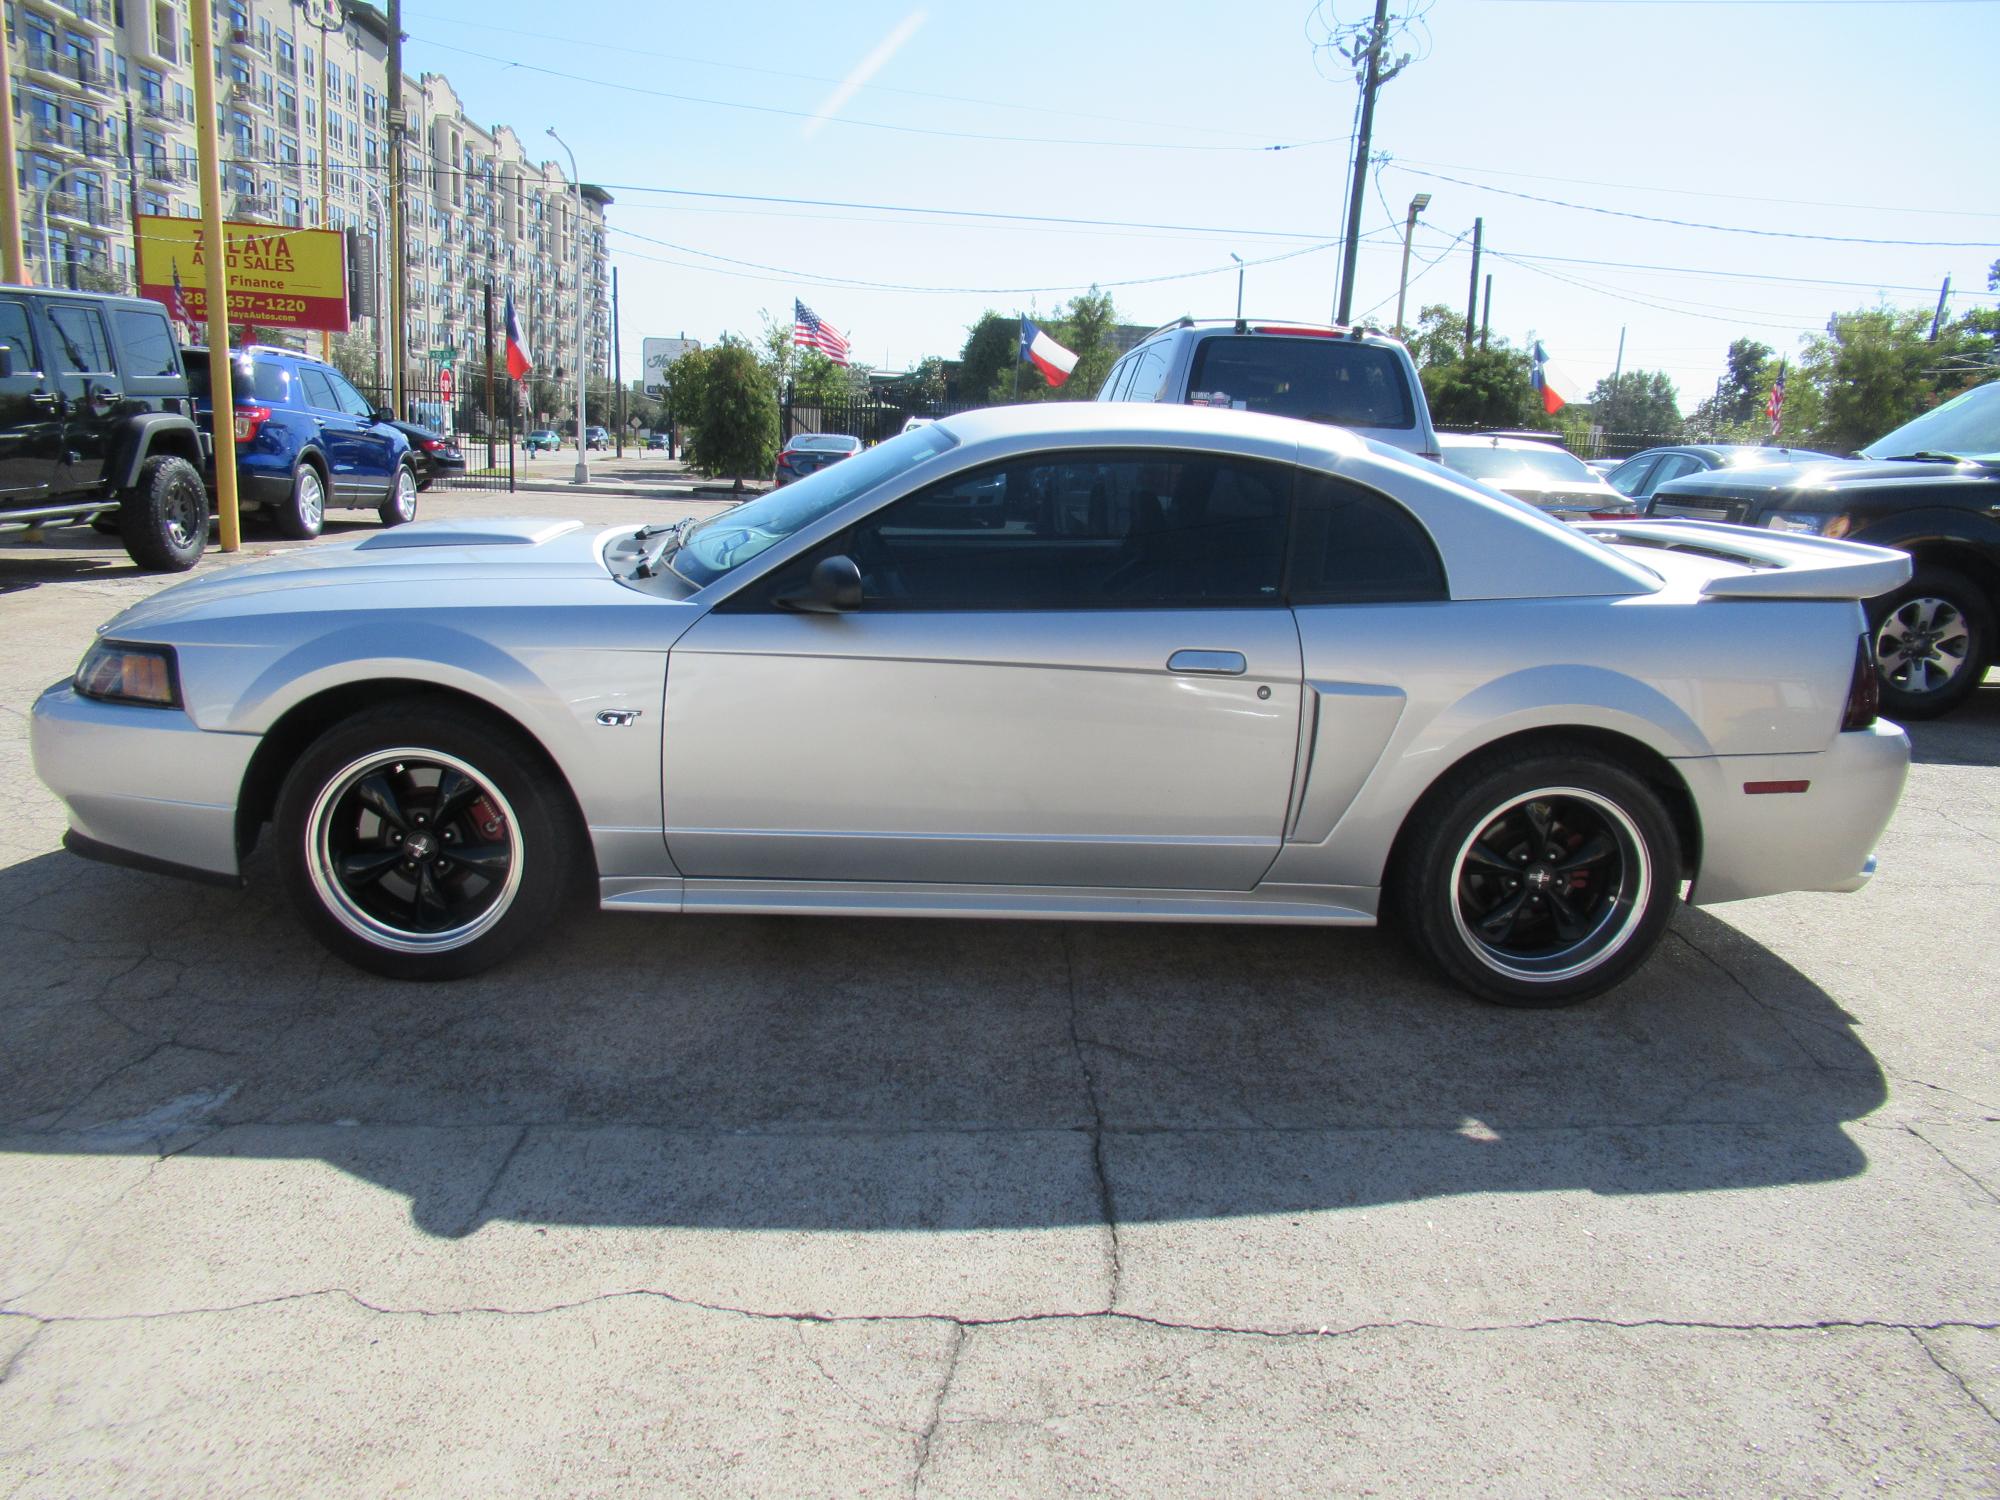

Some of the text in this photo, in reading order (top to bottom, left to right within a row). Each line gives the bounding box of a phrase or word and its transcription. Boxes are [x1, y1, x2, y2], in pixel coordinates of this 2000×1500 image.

[193, 229, 291, 257] ZLAYA
[192, 251, 295, 272] AO SALES
[230, 275, 285, 289] Finance
[184, 291, 306, 312] 28657-1220
[596, 709, 642, 727] GT
